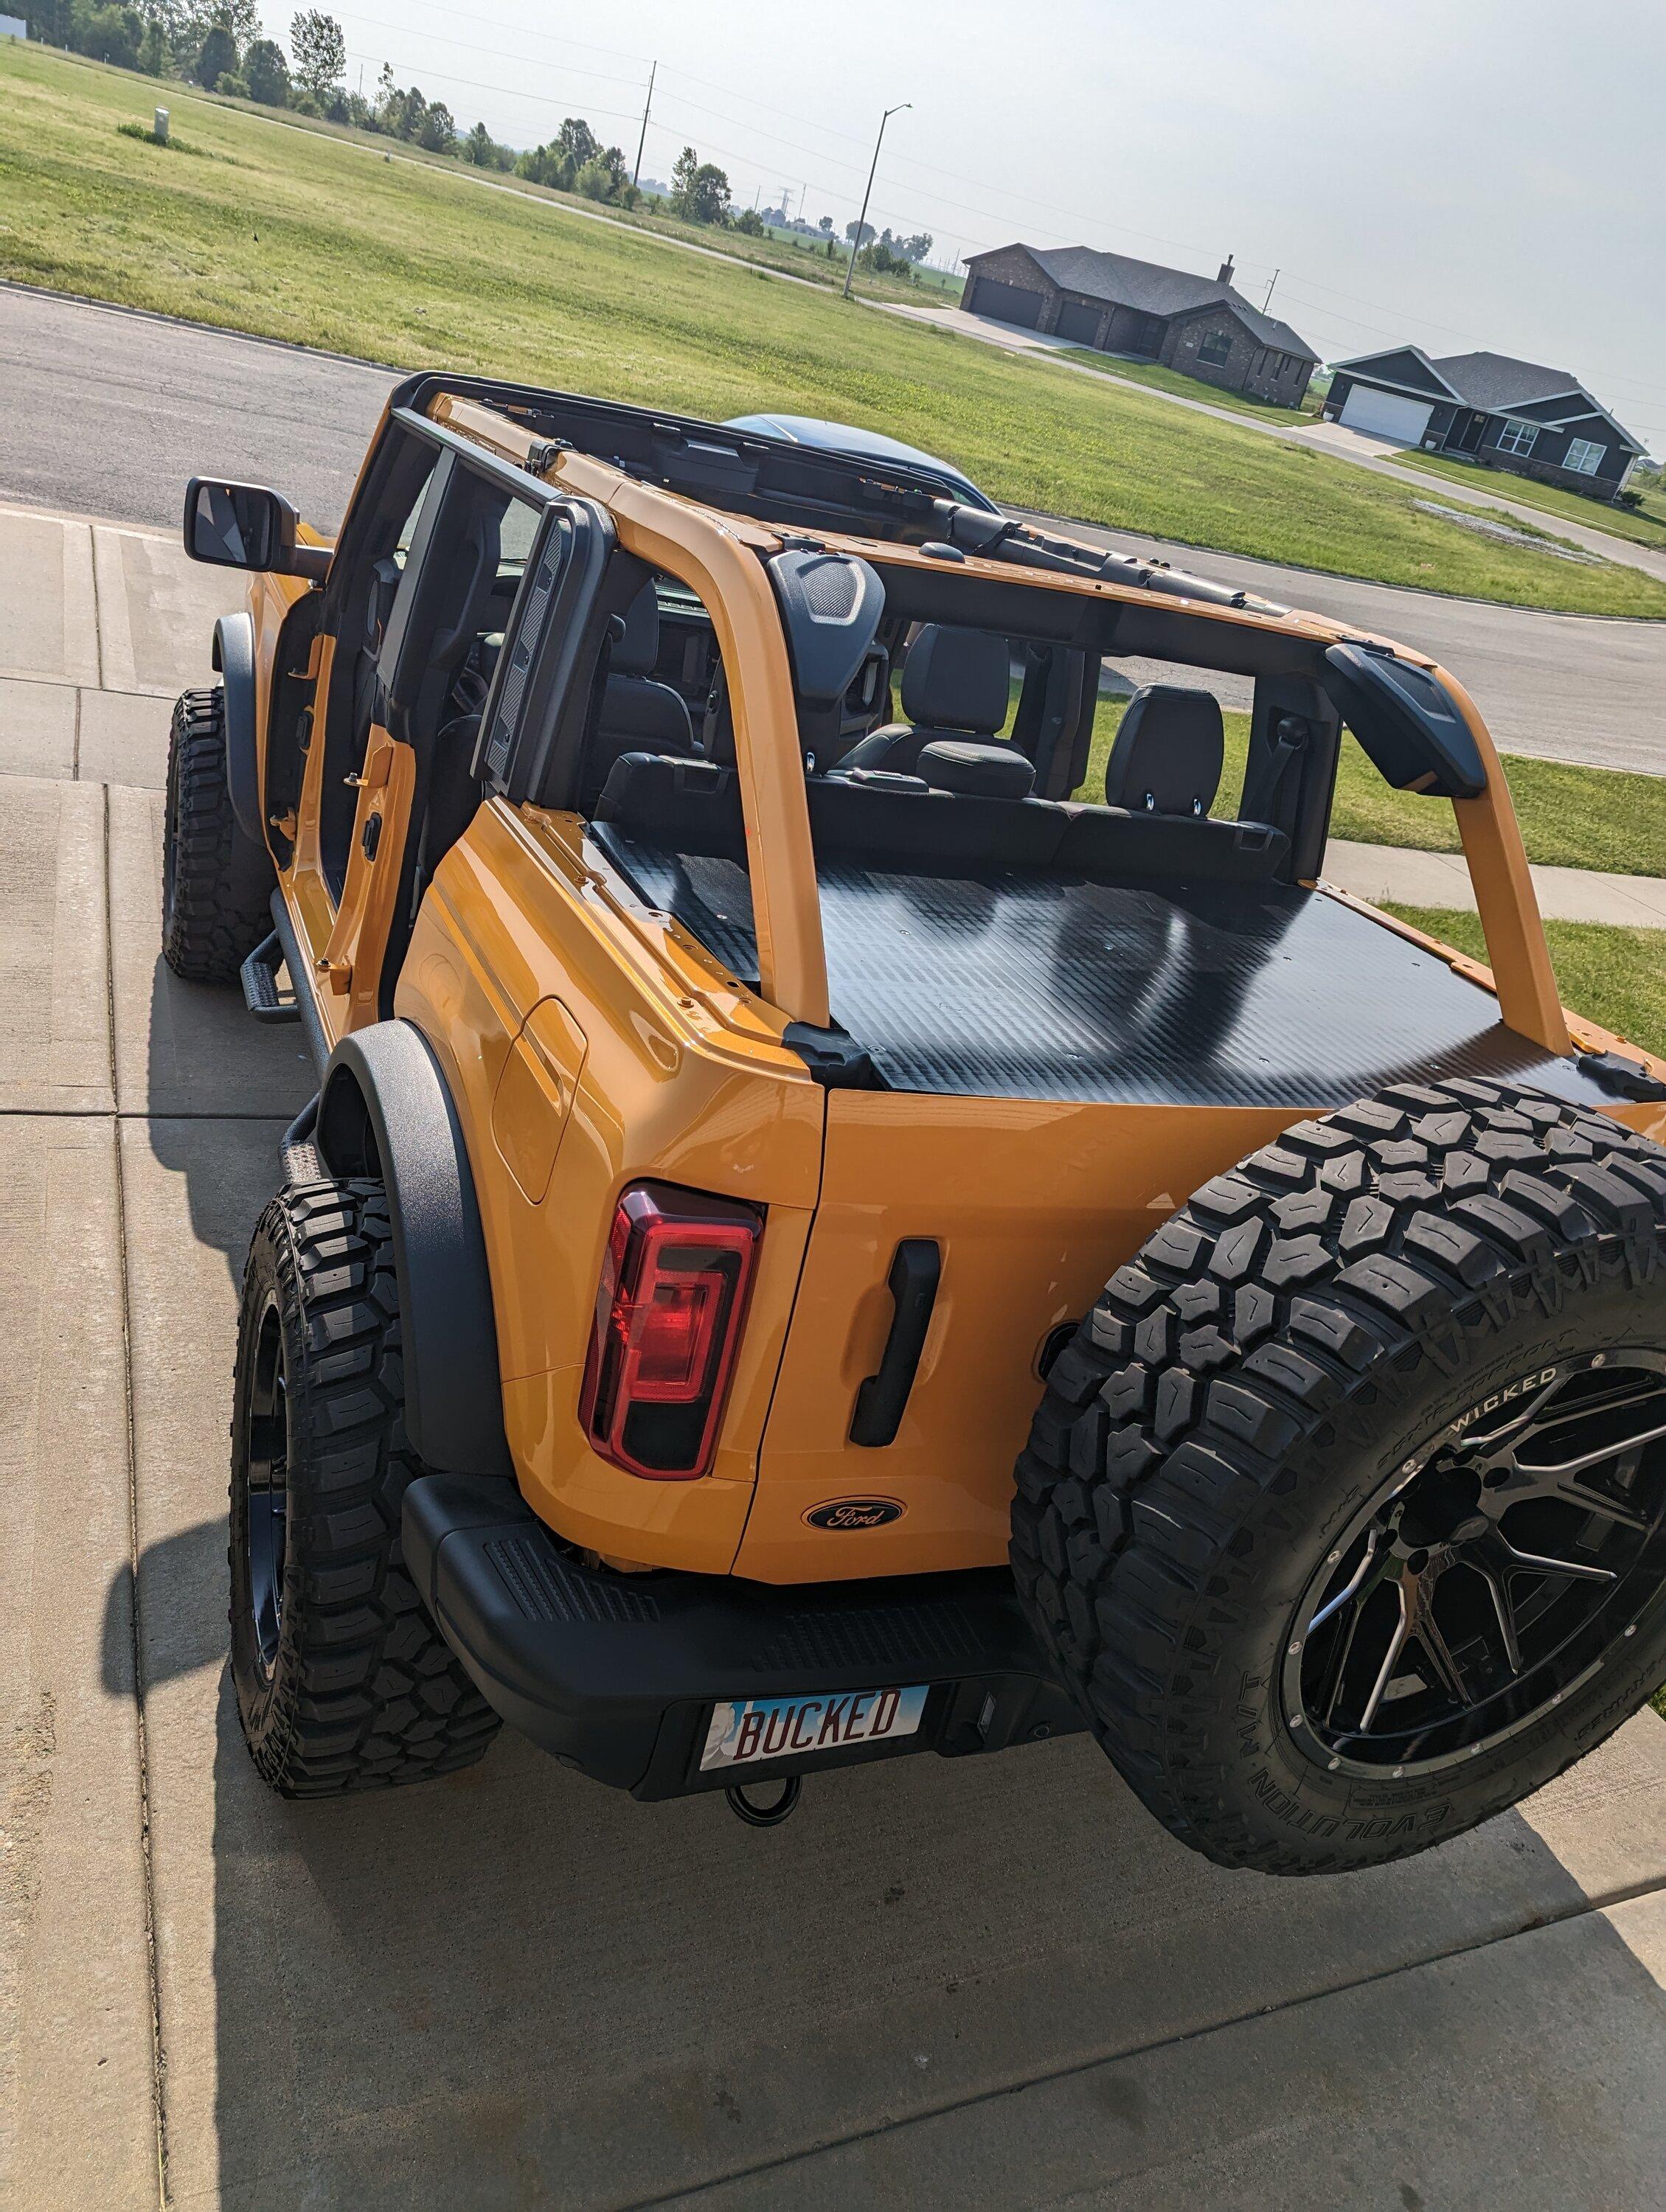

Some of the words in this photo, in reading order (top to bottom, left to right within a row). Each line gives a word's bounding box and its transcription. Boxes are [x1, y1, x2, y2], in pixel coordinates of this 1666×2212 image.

[1450, 1367, 1557, 1433] WICKED
[827, 1506, 885, 1526] Ford
[733, 1689, 901, 1761] BUCKED
[1248, 1768, 1451, 1841] EVOLUTION
